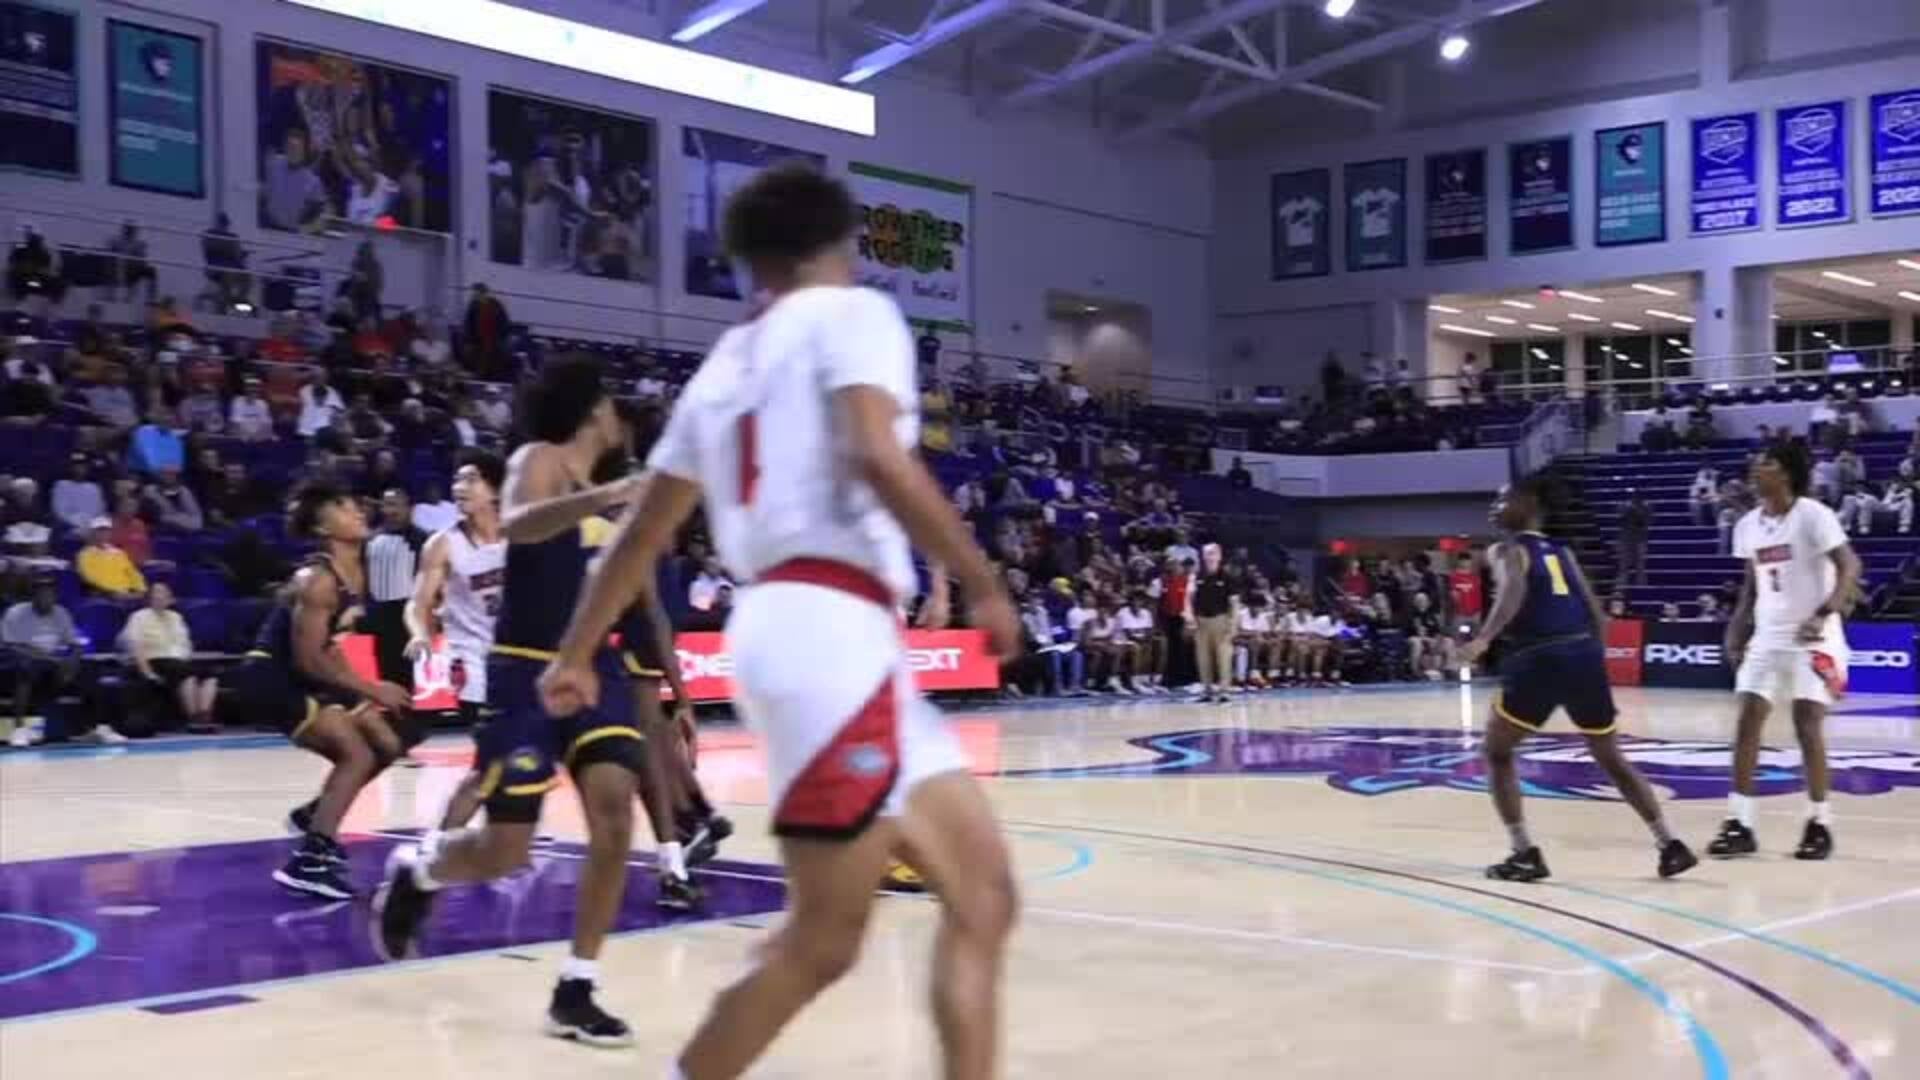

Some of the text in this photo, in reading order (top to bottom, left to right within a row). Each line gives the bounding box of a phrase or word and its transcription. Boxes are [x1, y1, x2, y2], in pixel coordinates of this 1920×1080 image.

[860, 203, 964, 247] ROWTHER
[1543, 553, 1569, 595] 1
[903, 648, 964, 671] EXT
[1644, 644, 1721, 665] AXE
